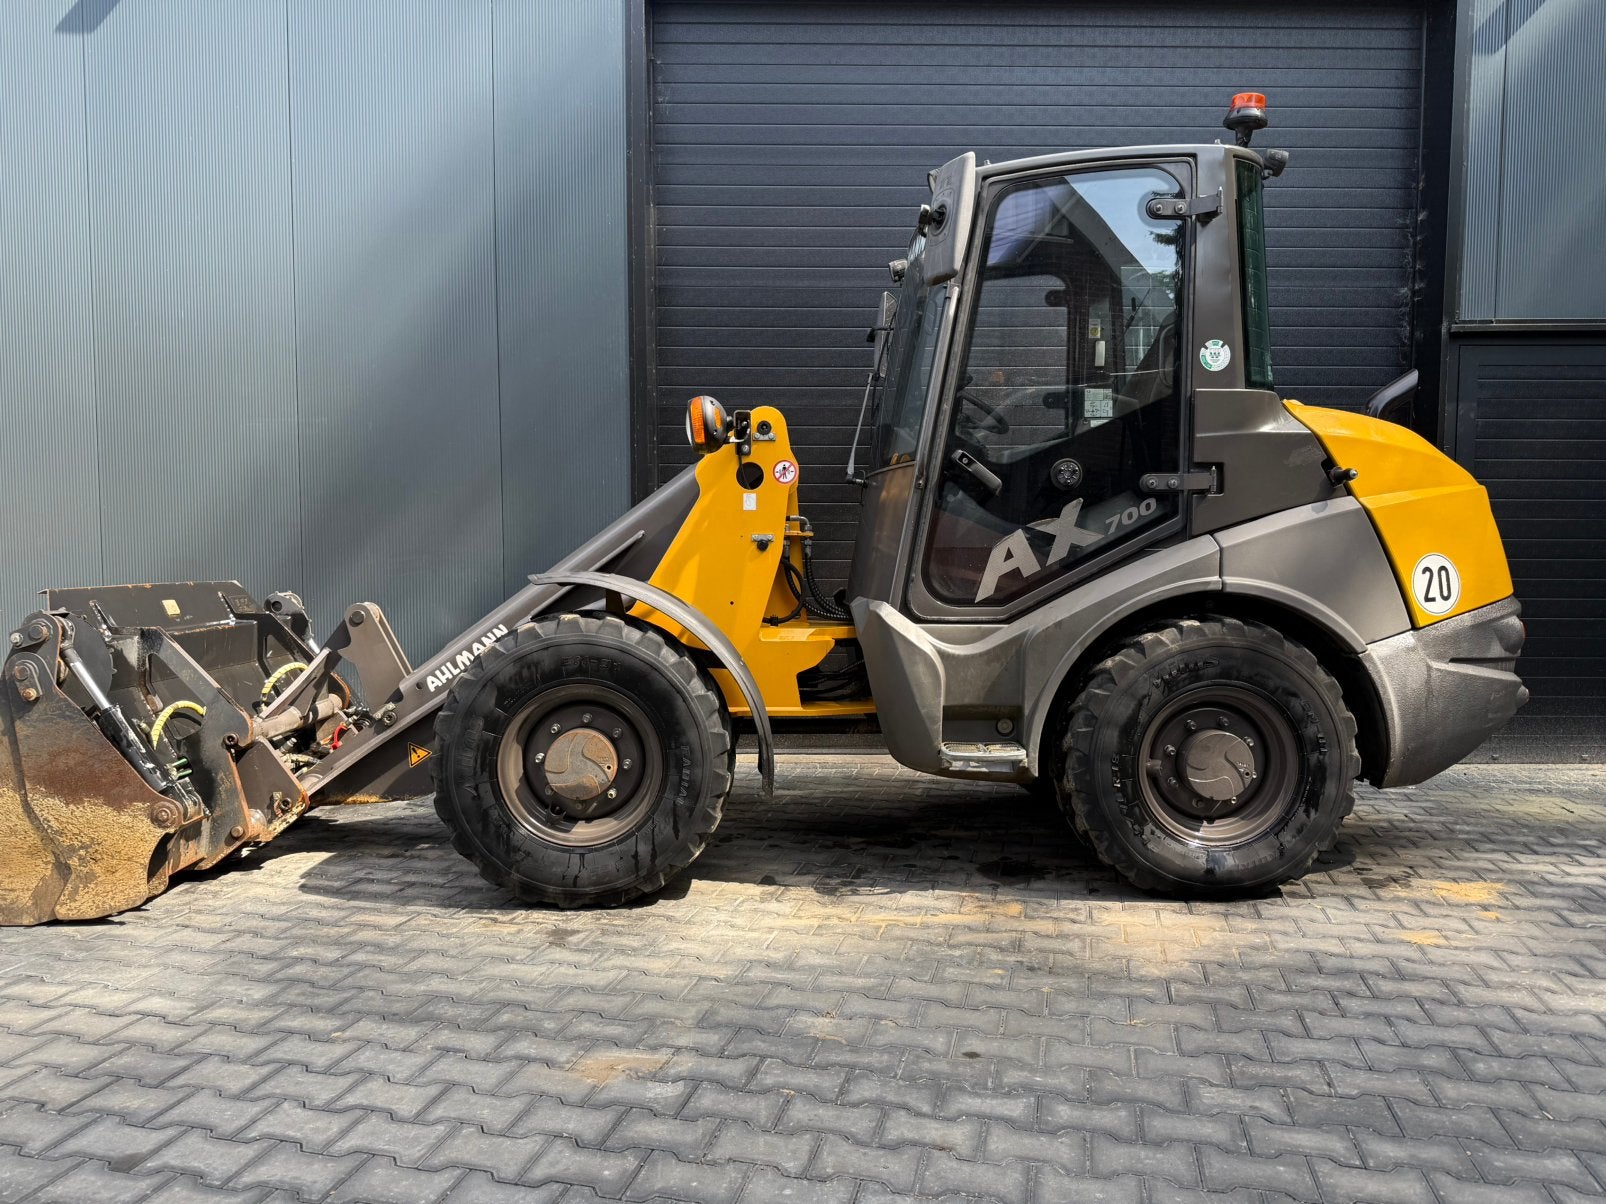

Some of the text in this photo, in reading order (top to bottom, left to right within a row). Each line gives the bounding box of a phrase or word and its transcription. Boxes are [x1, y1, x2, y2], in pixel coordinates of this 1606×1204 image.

[975, 497, 1157, 604] AX 700
[1421, 565, 1452, 603] 20
[426, 623, 509, 693] AHLMANN
